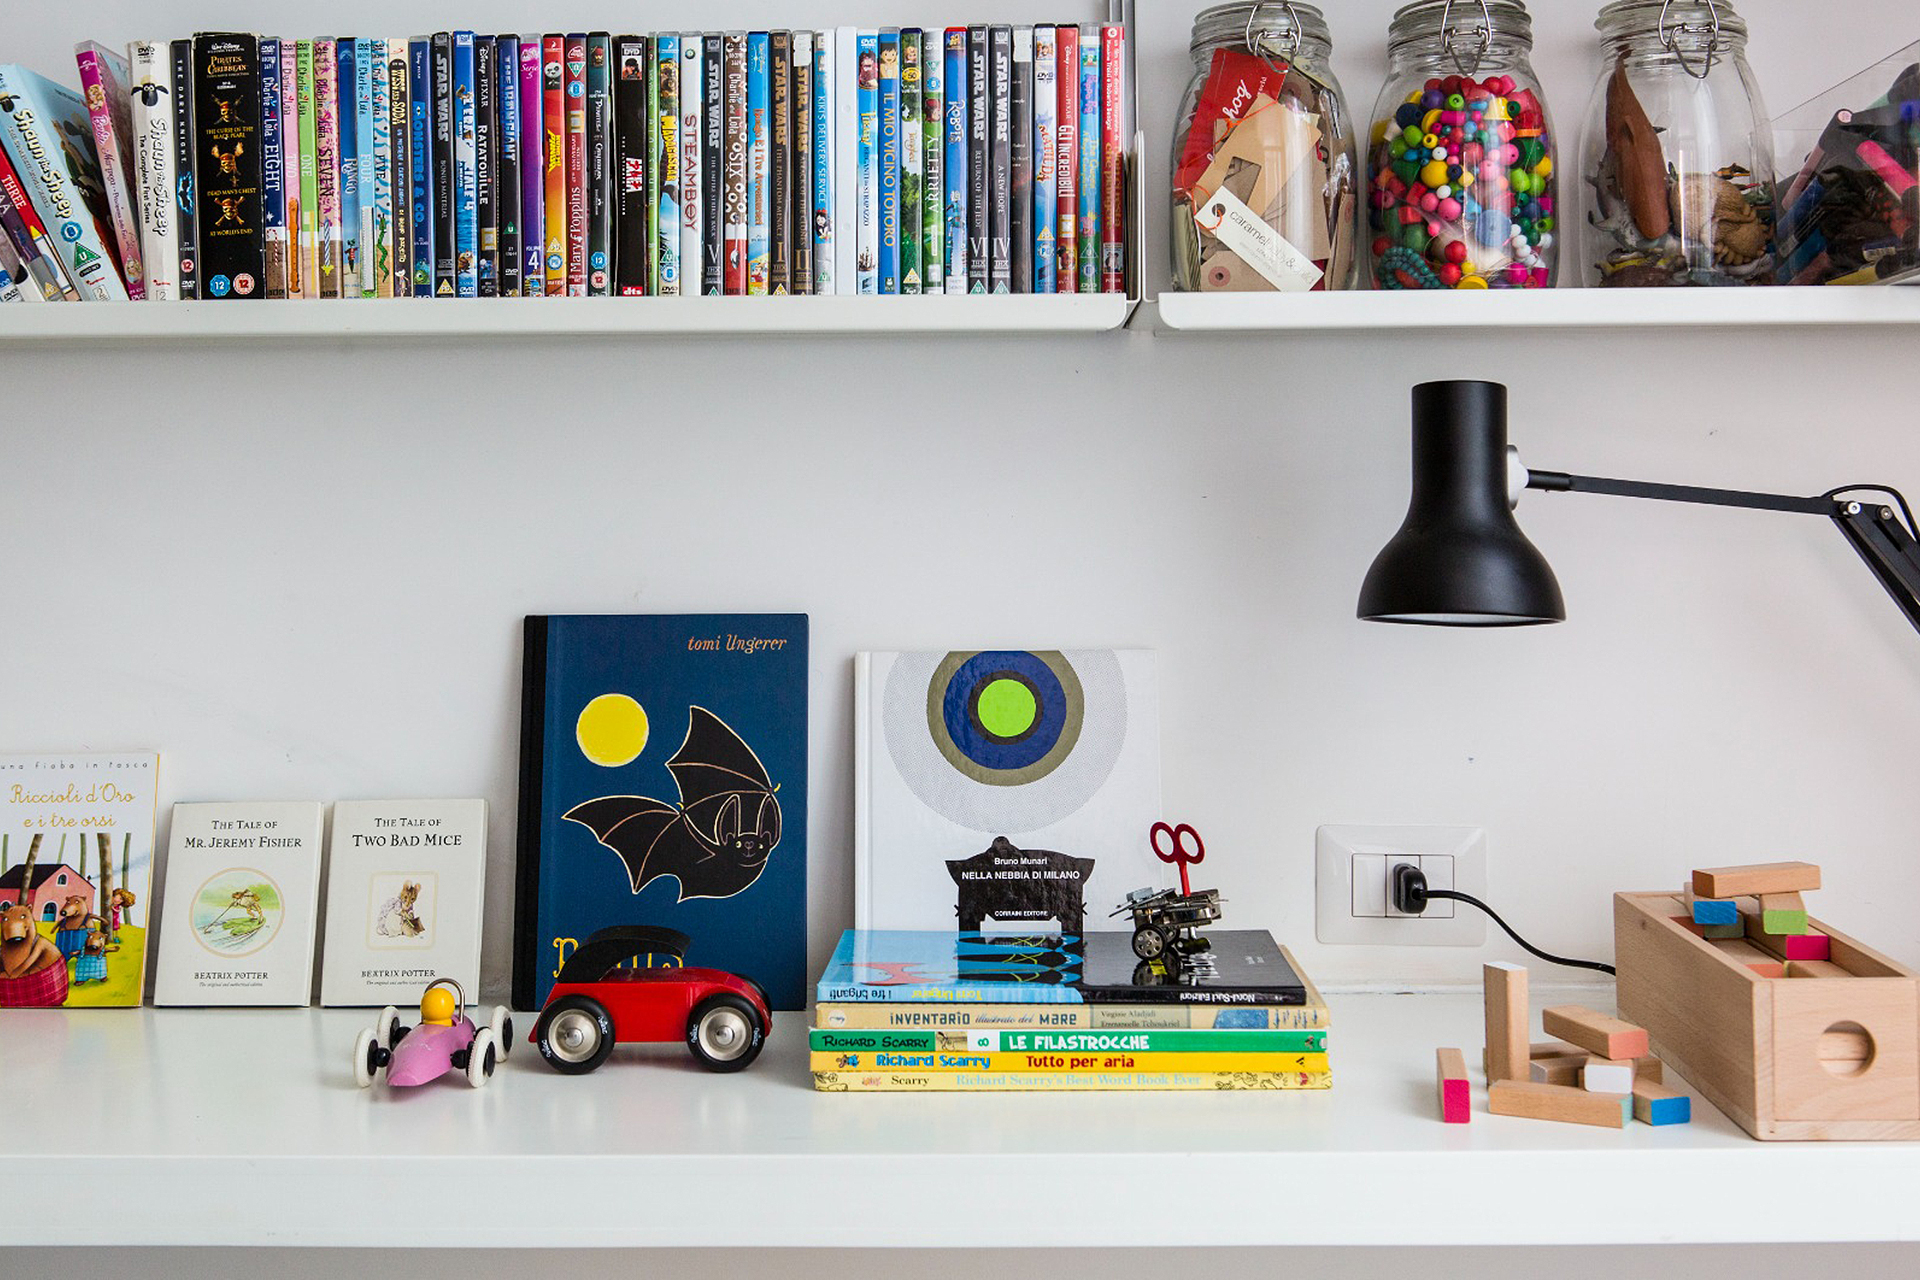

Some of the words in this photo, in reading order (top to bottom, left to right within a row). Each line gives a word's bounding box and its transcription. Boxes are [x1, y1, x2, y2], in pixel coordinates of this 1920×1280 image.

[436, 53, 448, 97] STAR
[504, 55, 512, 85] THE
[708, 60, 720, 103] STAR
[774, 56, 787, 101] STAR
[974, 51, 985, 95] STAR
[996, 52, 1008, 96] STAR
[262, 77, 275, 106] Charlie
[480, 78, 489, 108] PIXAR
[728, 74, 742, 103] Charlie
[798, 67, 809, 109] STAR
[883, 93, 895, 104] IL
[437, 98, 449, 142] WARS
[817, 95, 827, 120] KIKI'S
[974, 96, 985, 141] WARS
[996, 97, 1009, 142] WARS
[1104, 108, 1112, 131] Benigni
[264, 118, 277, 136] Lola
[708, 104, 720, 149] WARS
[729, 116, 742, 134] Lola
[775, 101, 788, 146] WARS
[798, 109, 810, 153] WARS
[883, 108, 896, 136] MIO
[1058, 125, 1075, 140] GLI
[150, 118, 167, 171] Shaun
[412, 101, 426, 182] MONSTERS
[504, 121, 515, 160] GIANT
[660, 116, 679, 182] MADAGASCAR
[817, 123, 827, 166] DELIVERY
[1037, 124, 1055, 182] MATILDA
[13, 108, 46, 160] Shaun
[40, 168, 73, 219] Sheep
[140, 149, 149, 184] Complete
[264, 144, 280, 191] EIGHT
[302, 154, 312, 177] ONE
[360, 153, 372, 184] FOUR
[375, 154, 386, 180] FIVE
[478, 125, 489, 205] RATATOUILLE
[729, 152, 744, 178] SIX
[776, 148, 784, 163] THE
[883, 139, 896, 188] VICINO
[974, 150, 982, 181] RETURN
[1104, 142, 1112, 169] che
[318, 148, 334, 197] SEVEN
[342, 157, 358, 194] RANGO
[684, 114, 698, 231] STEAMBOY
[799, 155, 807, 186] ATTACK
[926, 134, 939, 213] ARRIETTY
[1058, 143, 1076, 197] INCREDIBILI
[1, 174, 27, 210] THREE
[143, 186, 151, 200] First
[413, 186, 425, 198] &
[776, 165, 784, 206] PHANTOM
[799, 187, 807, 198] OF
[817, 168, 827, 204] SERVICE
[974, 182, 982, 192] OF
[144, 202, 152, 223] Series
[152, 185, 170, 236] Sheep
[463, 201, 475, 211] 4
[569, 187, 583, 233] Poppins
[799, 199, 807, 214] THE
[862, 187, 871, 227] STRAPAZZO
[974, 196, 982, 210] THE
[998, 192, 1006, 214] HOPE
[1103, 171, 1112, 230] piangere
[413, 202, 425, 228] CO.
[776, 208, 784, 237] MENACE
[883, 190, 896, 247] TOTORO
[974, 211, 983, 229] JEDI
[1229, 209, 1270, 246] caramel
[799, 215, 807, 245] CLONES
[80, 252, 87, 261] U
[528, 251, 539, 270] 4
[570, 243, 583, 272] Mary
[707, 244, 720, 263] V
[795, 249, 811, 270] II
[970, 237, 987, 258] VI
[992, 237, 1010, 258] IV
[239, 279, 249, 288] 12
[623, 287, 643, 295] dts
[687, 634, 721, 651] tomi
[726, 633, 787, 654] Ungerer
[9, 783, 82, 804] Riccioli
[85, 782, 136, 803] d'Oro
[23, 818, 34, 828] e
[48, 812, 78, 828] tre
[80, 814, 117, 828] orsi
[211, 820, 234, 830] THE
[236, 820, 262, 830] TALE
[264, 821, 278, 829] OF
[374, 818, 397, 828] THE
[399, 817, 425, 828] TALE
[428, 818, 442, 827] OF
[184, 837, 207, 848] MR.
[208, 838, 257, 849] JEREMY
[258, 837, 302, 848] FISHER
[352, 834, 386, 847] TWO
[390, 834, 420, 847] BAD
[424, 834, 462, 847] MICE
[1020, 857, 1048, 865] Munari
[961, 871, 993, 880] NELLA
[994, 871, 1030, 880] NEBBIA
[1032, 871, 1042, 880] DI
[1043, 871, 1080, 880] MILANO
[194, 972, 232, 980] BEATRIX
[234, 972, 268, 980] POTTER
[829, 990, 869, 1001] briganti
[871, 990, 887, 999] tre
[1210, 993, 1256, 1003] Nord-Sud
[975, 1013, 1016, 1025] illustrato
[1101, 1010, 1127, 1018] Virginie
[822, 1036, 877, 1047] RICHARD
[882, 1035, 930, 1048] SCARRY
[1008, 1036, 1030, 1050] LE
[1034, 1035, 1150, 1050] FILASTROCCHE
[876, 1054, 934, 1066] Richard
[939, 1054, 991, 1069] Scarry
[1026, 1056, 1064, 1068] Tutto
[1070, 1057, 1098, 1069] per
[1104, 1055, 1135, 1068] aria
[891, 1075, 930, 1087] Scarry
[956, 1075, 1005, 1086] Richard
[1010, 1075, 1063, 1087] Scarry's
[1066, 1074, 1094, 1086] Best
[1097, 1074, 1133, 1086] Word
[1136, 1074, 1170, 1086] Book
[1174, 1074, 1200, 1086] Ever
